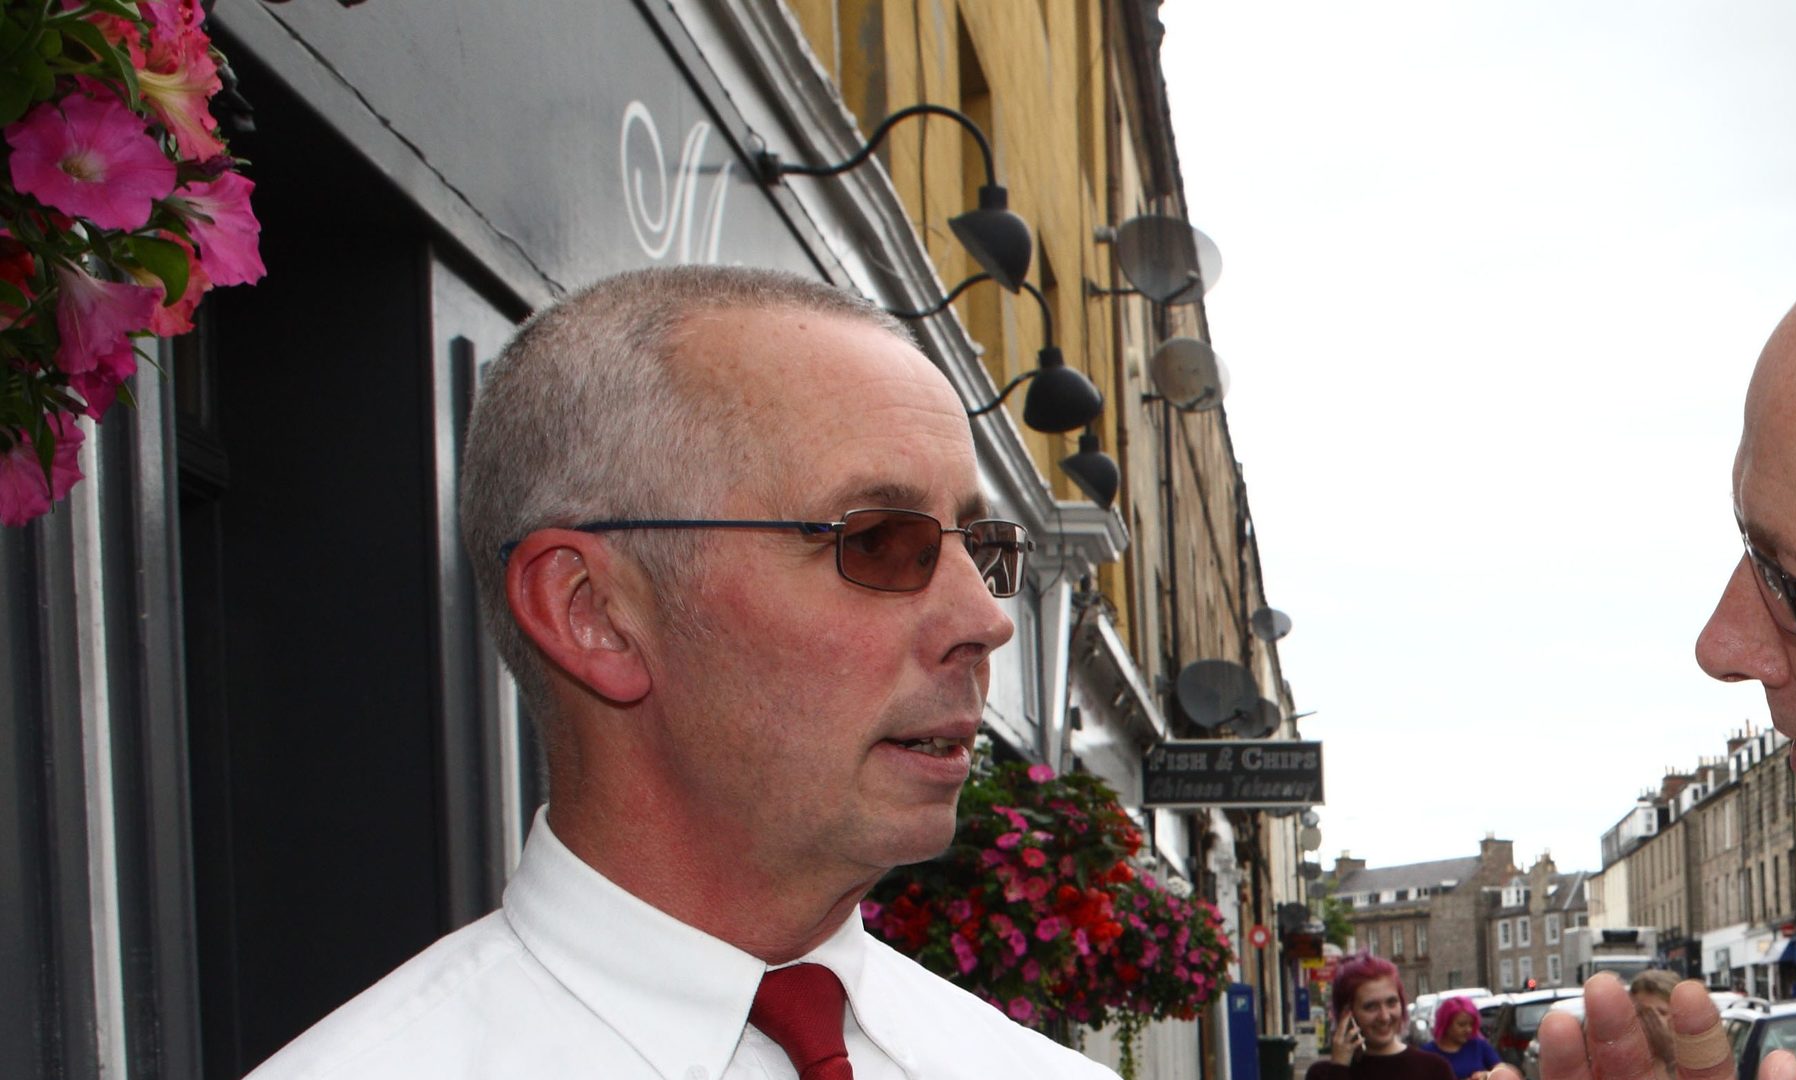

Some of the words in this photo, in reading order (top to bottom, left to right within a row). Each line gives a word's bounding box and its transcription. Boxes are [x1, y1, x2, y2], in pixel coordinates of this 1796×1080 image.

[1149, 747, 1208, 771] FISH
[1214, 746, 1234, 772] &
[1241, 747, 1318, 771] CHIPS
[1151, 776, 1225, 799] Chinese
[1232, 774, 1318, 802] Takeaway
